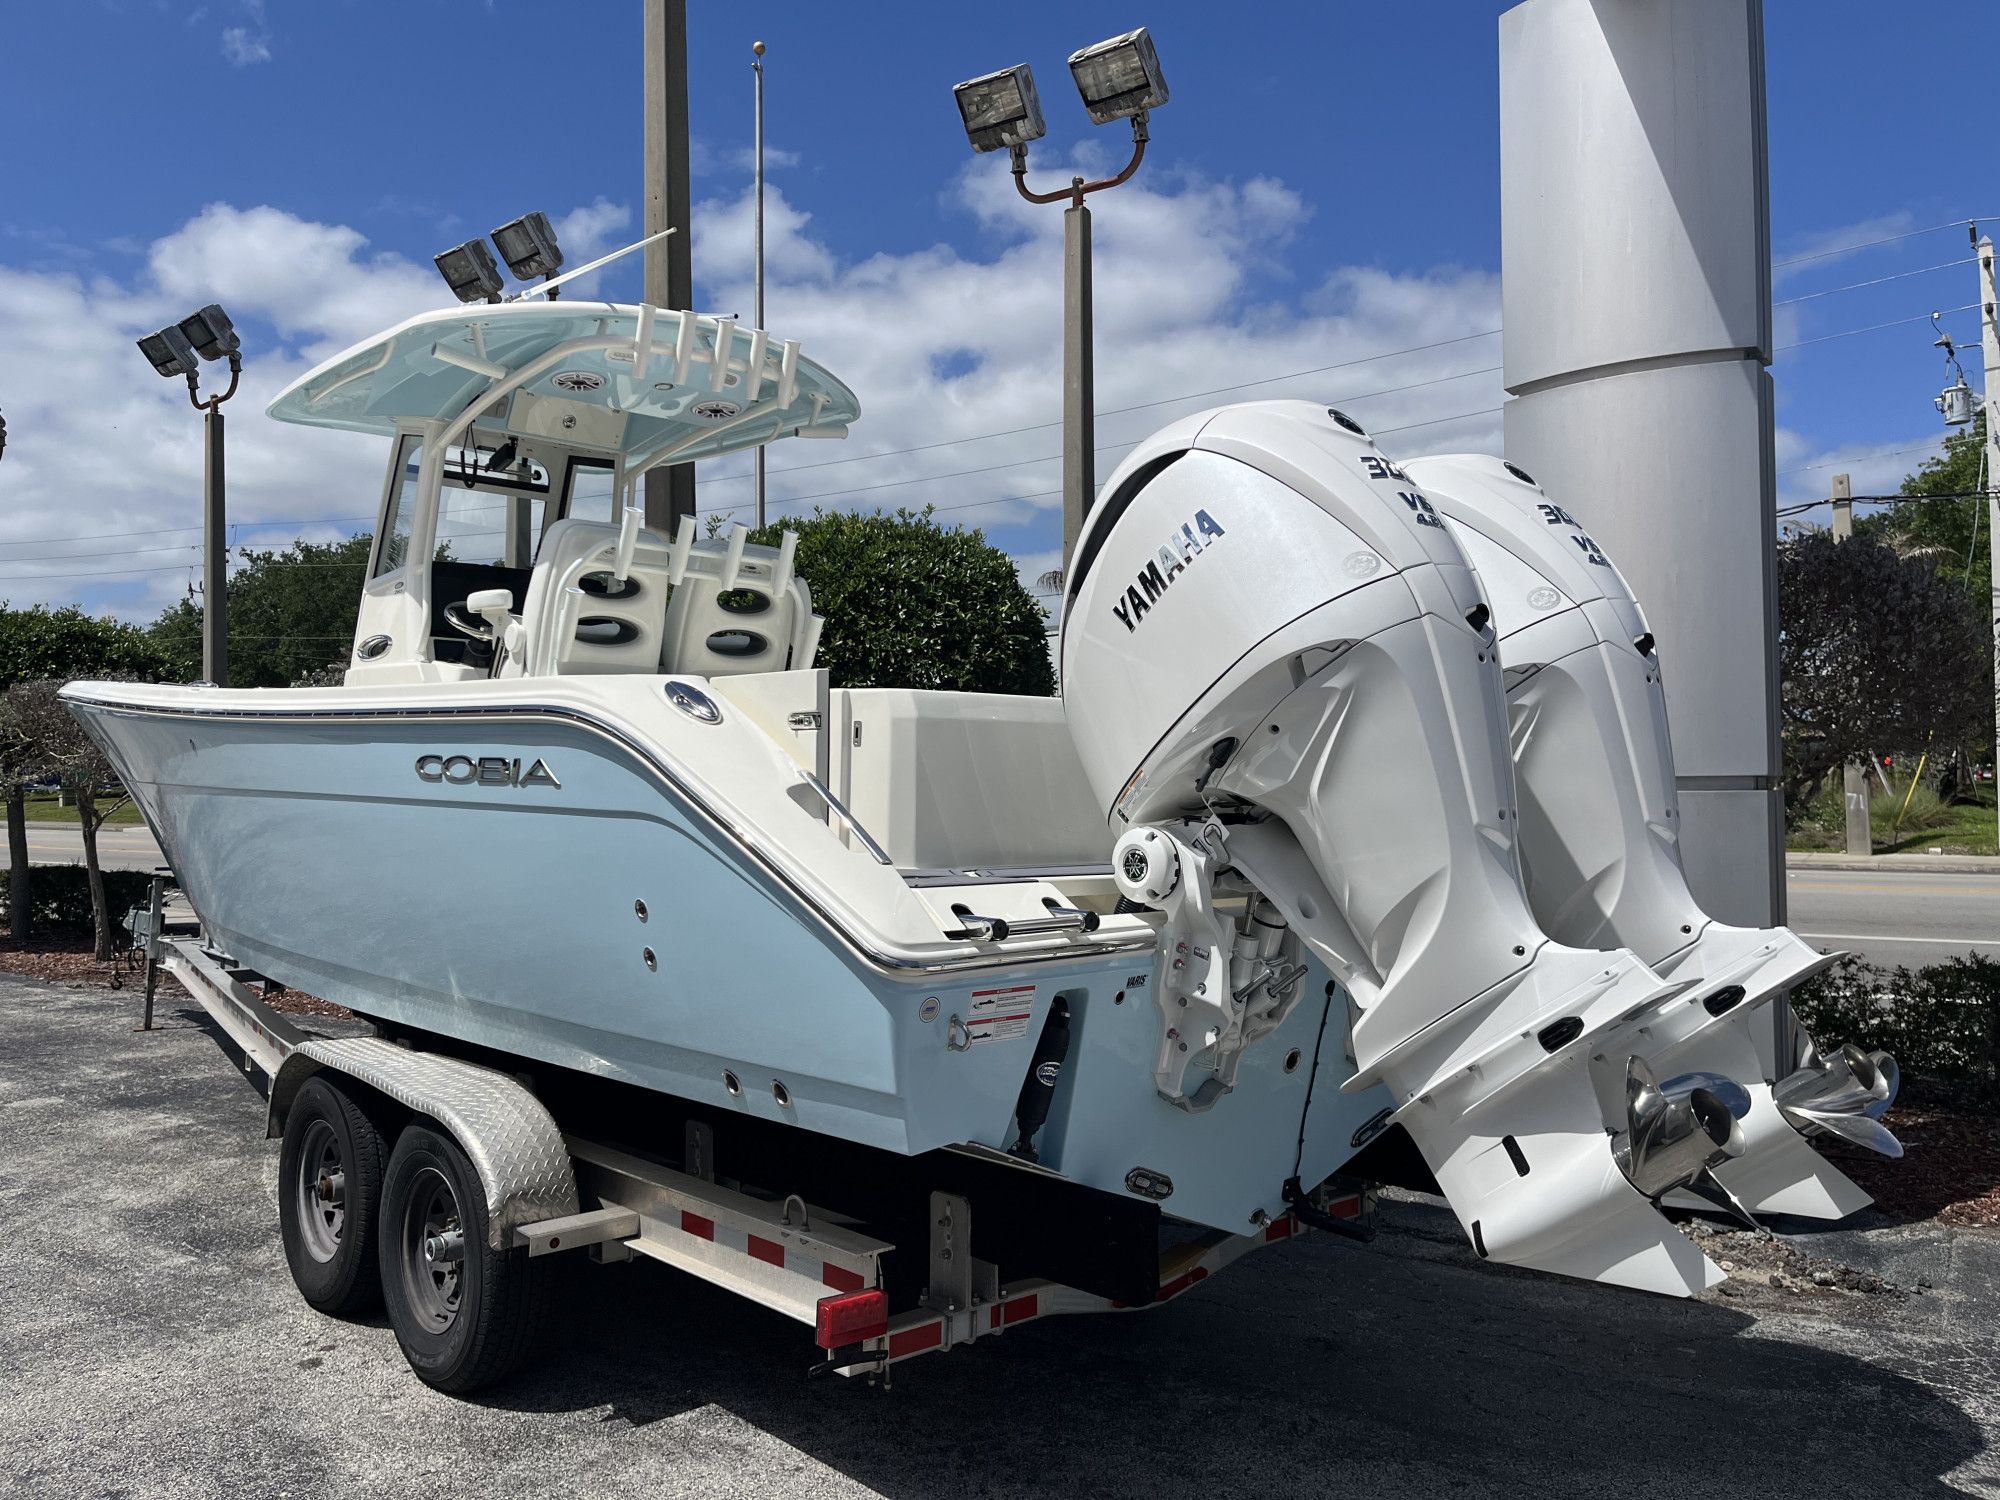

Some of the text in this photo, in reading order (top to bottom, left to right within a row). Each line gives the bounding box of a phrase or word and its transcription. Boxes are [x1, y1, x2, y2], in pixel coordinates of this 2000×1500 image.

[1359, 456, 1416, 487] 30
[1536, 504, 1582, 529] 30
[1112, 509, 1225, 634] YAMAHA
[415, 754, 562, 790] COBIA
[1846, 792, 1864, 809] 71
